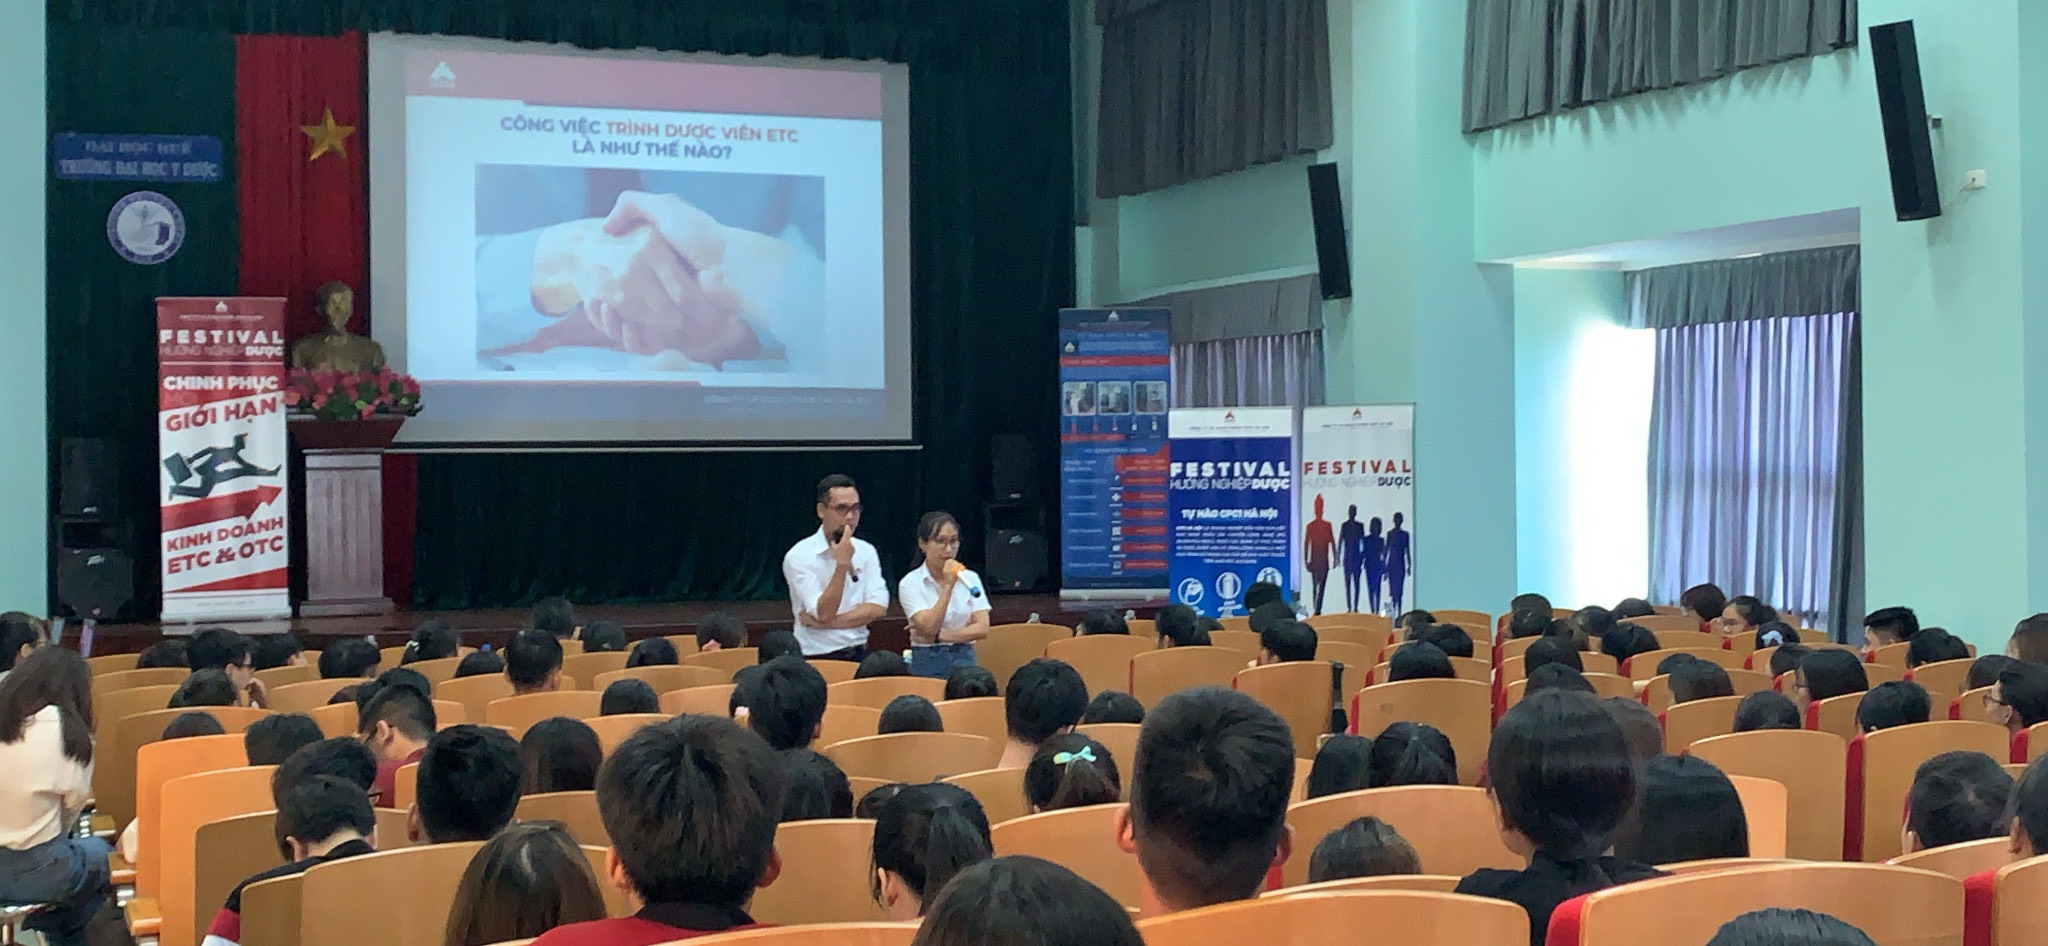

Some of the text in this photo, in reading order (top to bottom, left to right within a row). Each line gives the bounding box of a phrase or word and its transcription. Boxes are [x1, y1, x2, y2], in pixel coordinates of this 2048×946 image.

[500, 113, 799, 143] CÔNG VIỆC TRÌNH DƯỢC VIÊN ETC
[572, 136, 732, 159] LÀ NHƯ THẾ NÀO?
[160, 329, 284, 344] FESTIVAL
[163, 375, 279, 394] CHINH PHỤC
[165, 396, 277, 432] GIỚI HẠN
[1170, 461, 1290, 477] FESTIVAL
[1303, 459, 1412, 475] FESTIVAL
[1377, 476, 1412, 490] DƯỢC
[166, 516, 284, 552] KINH DOANH
[167, 534, 284, 574] ETC & OTC
